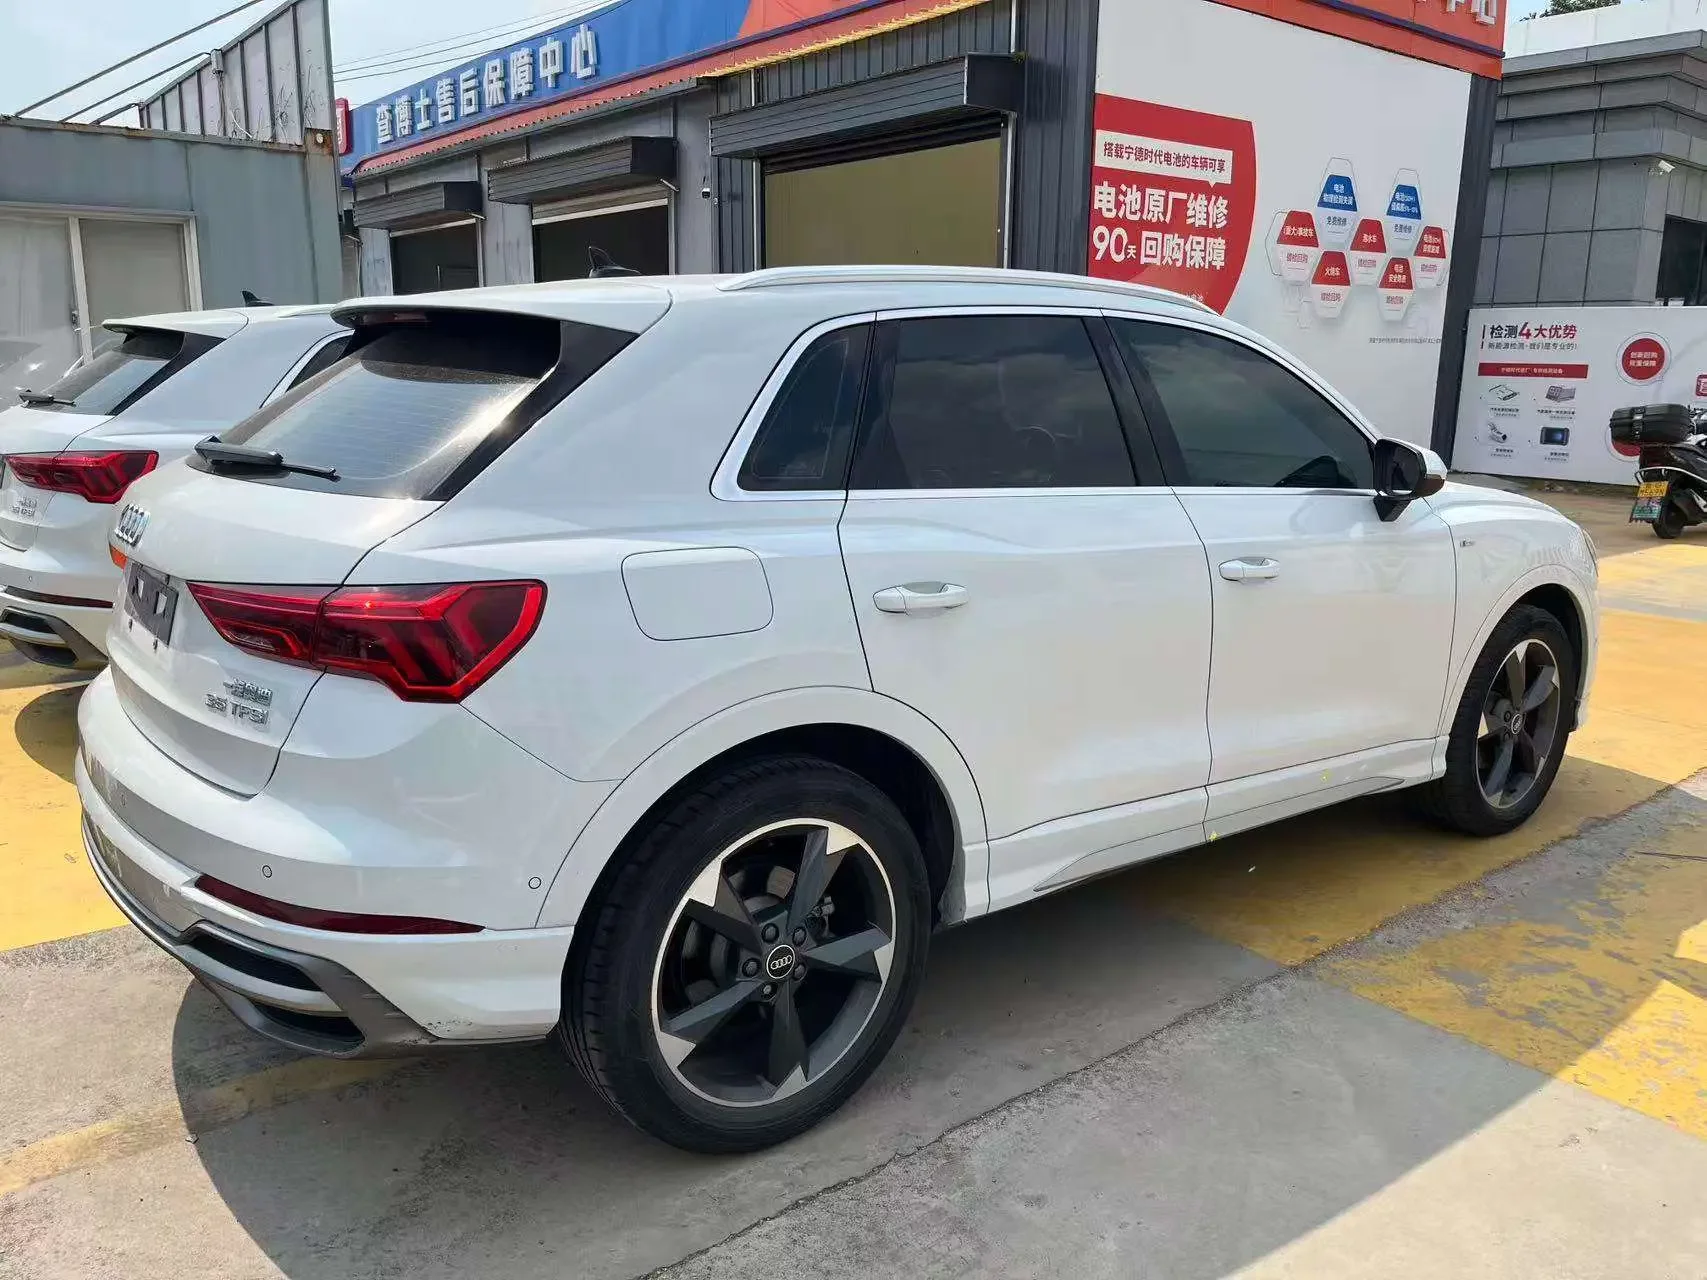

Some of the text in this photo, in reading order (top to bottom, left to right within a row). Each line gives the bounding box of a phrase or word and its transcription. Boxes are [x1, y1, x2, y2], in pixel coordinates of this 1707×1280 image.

[376, 24, 598, 144] 查博士售后保障中心
[1103, 141, 1226, 174] 搭载宁德时代电池的车辆可享
[1093, 180, 1229, 229] 电池原厂维修
[1490, 322, 1577, 339] 检测4大优势
